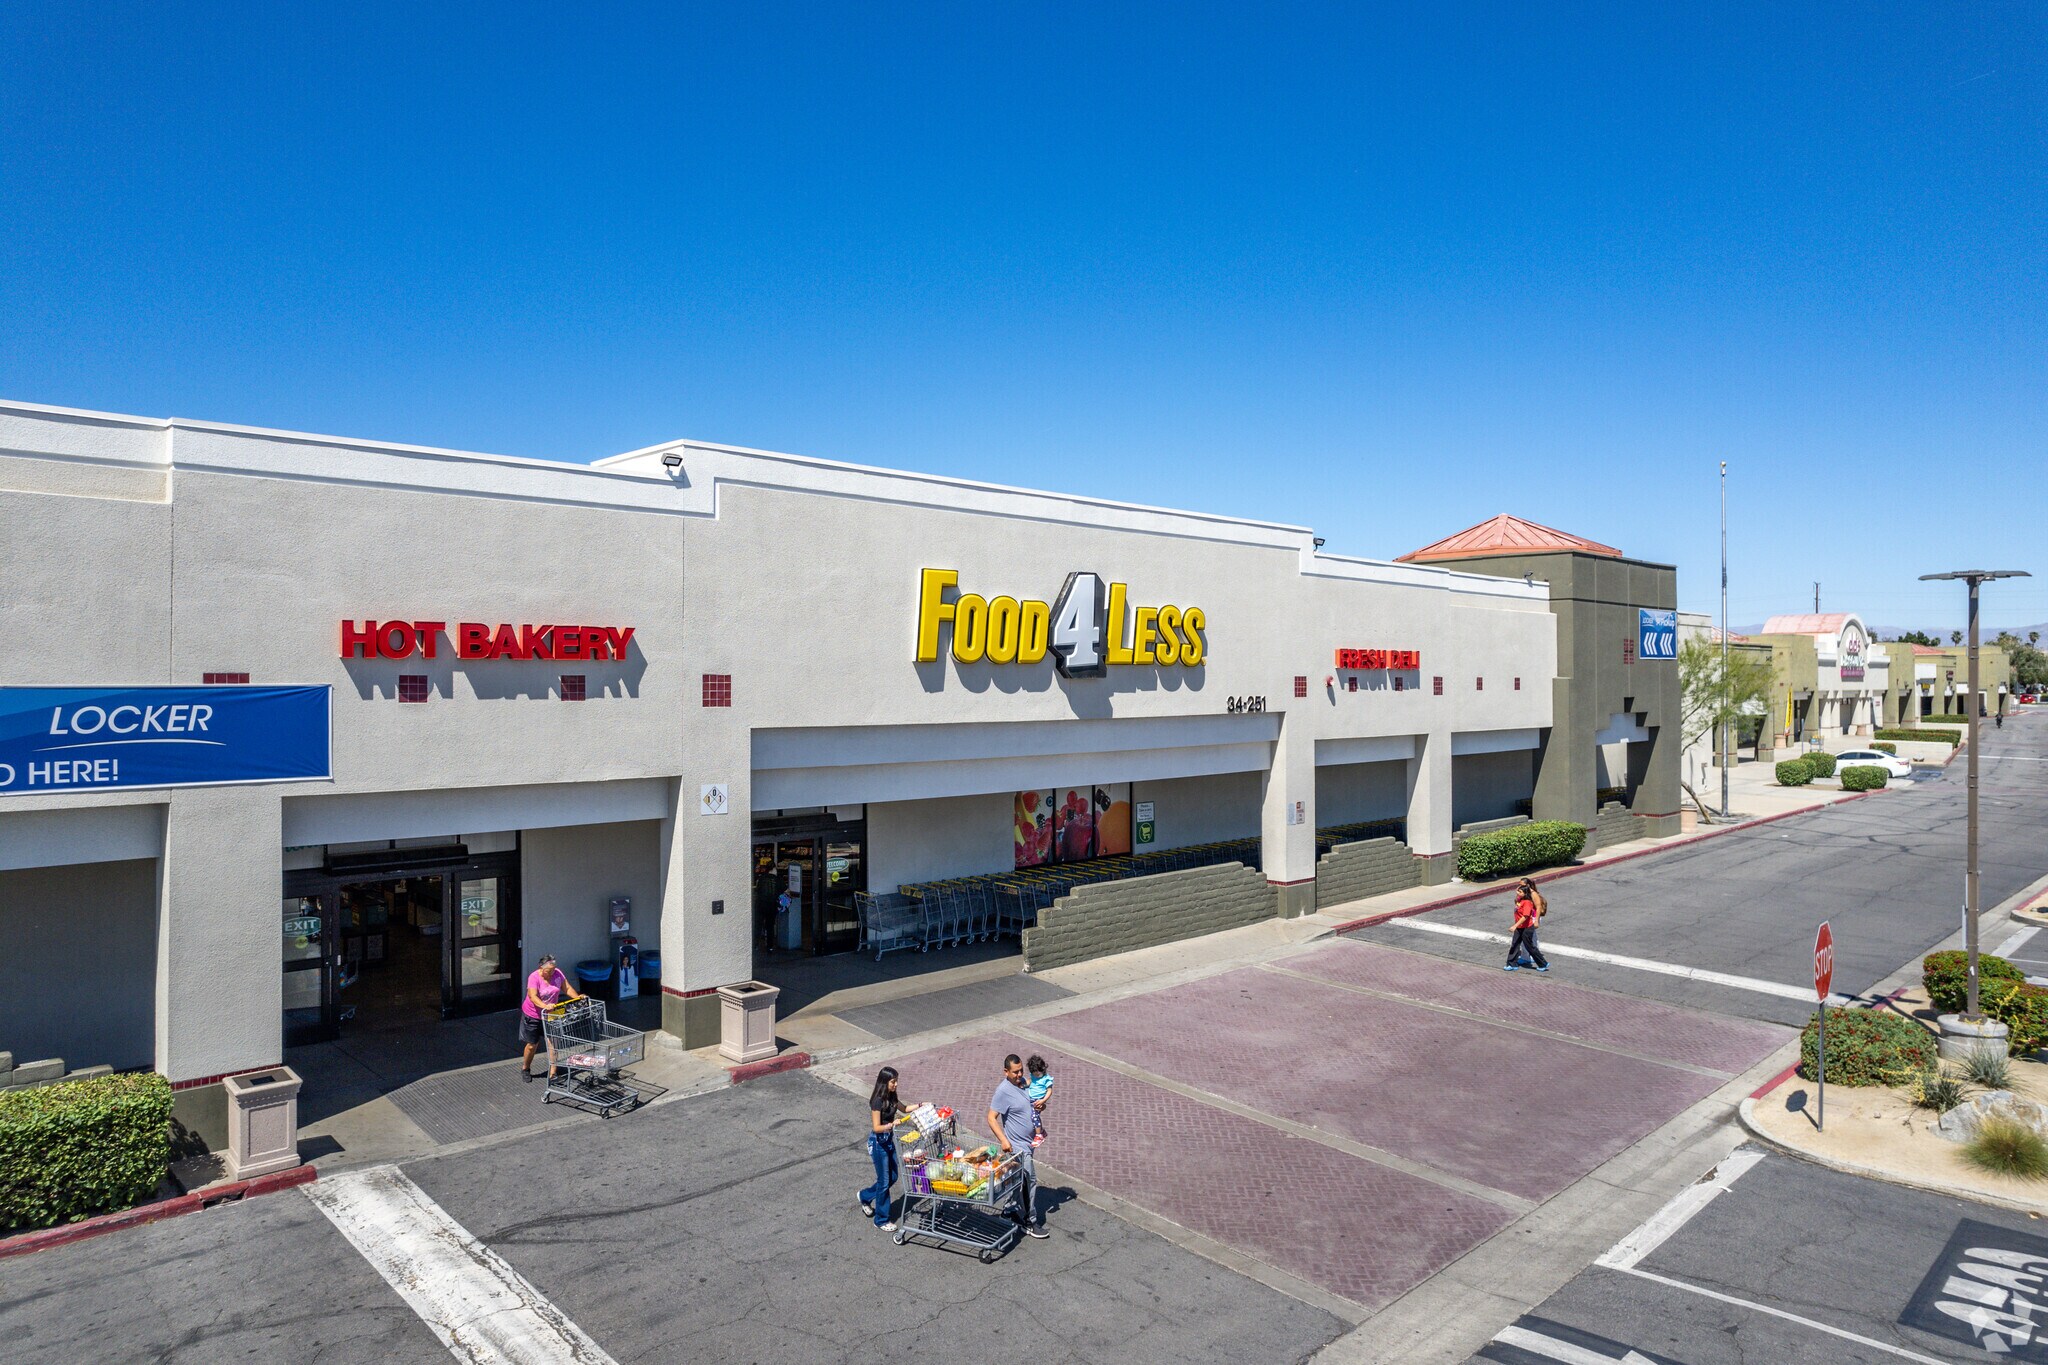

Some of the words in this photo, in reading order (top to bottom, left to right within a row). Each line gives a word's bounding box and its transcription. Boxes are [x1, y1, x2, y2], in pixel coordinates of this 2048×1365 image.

[914, 568, 1050, 665] FOOD
[1049, 571, 1106, 678] 4
[1105, 582, 1205, 667] LESS
[340, 620, 445, 659] HOT
[457, 622, 636, 661] BAKERY
[1335, 649, 1386, 669] FRESH
[1387, 650, 1420, 669] DELI
[50, 705, 213, 735] LOCKER
[28, 759, 119, 785] HERE!
[461, 900, 488, 910] EXIT
[284, 919, 317, 932] EXIT
[1815, 944, 1832, 980] STOP
